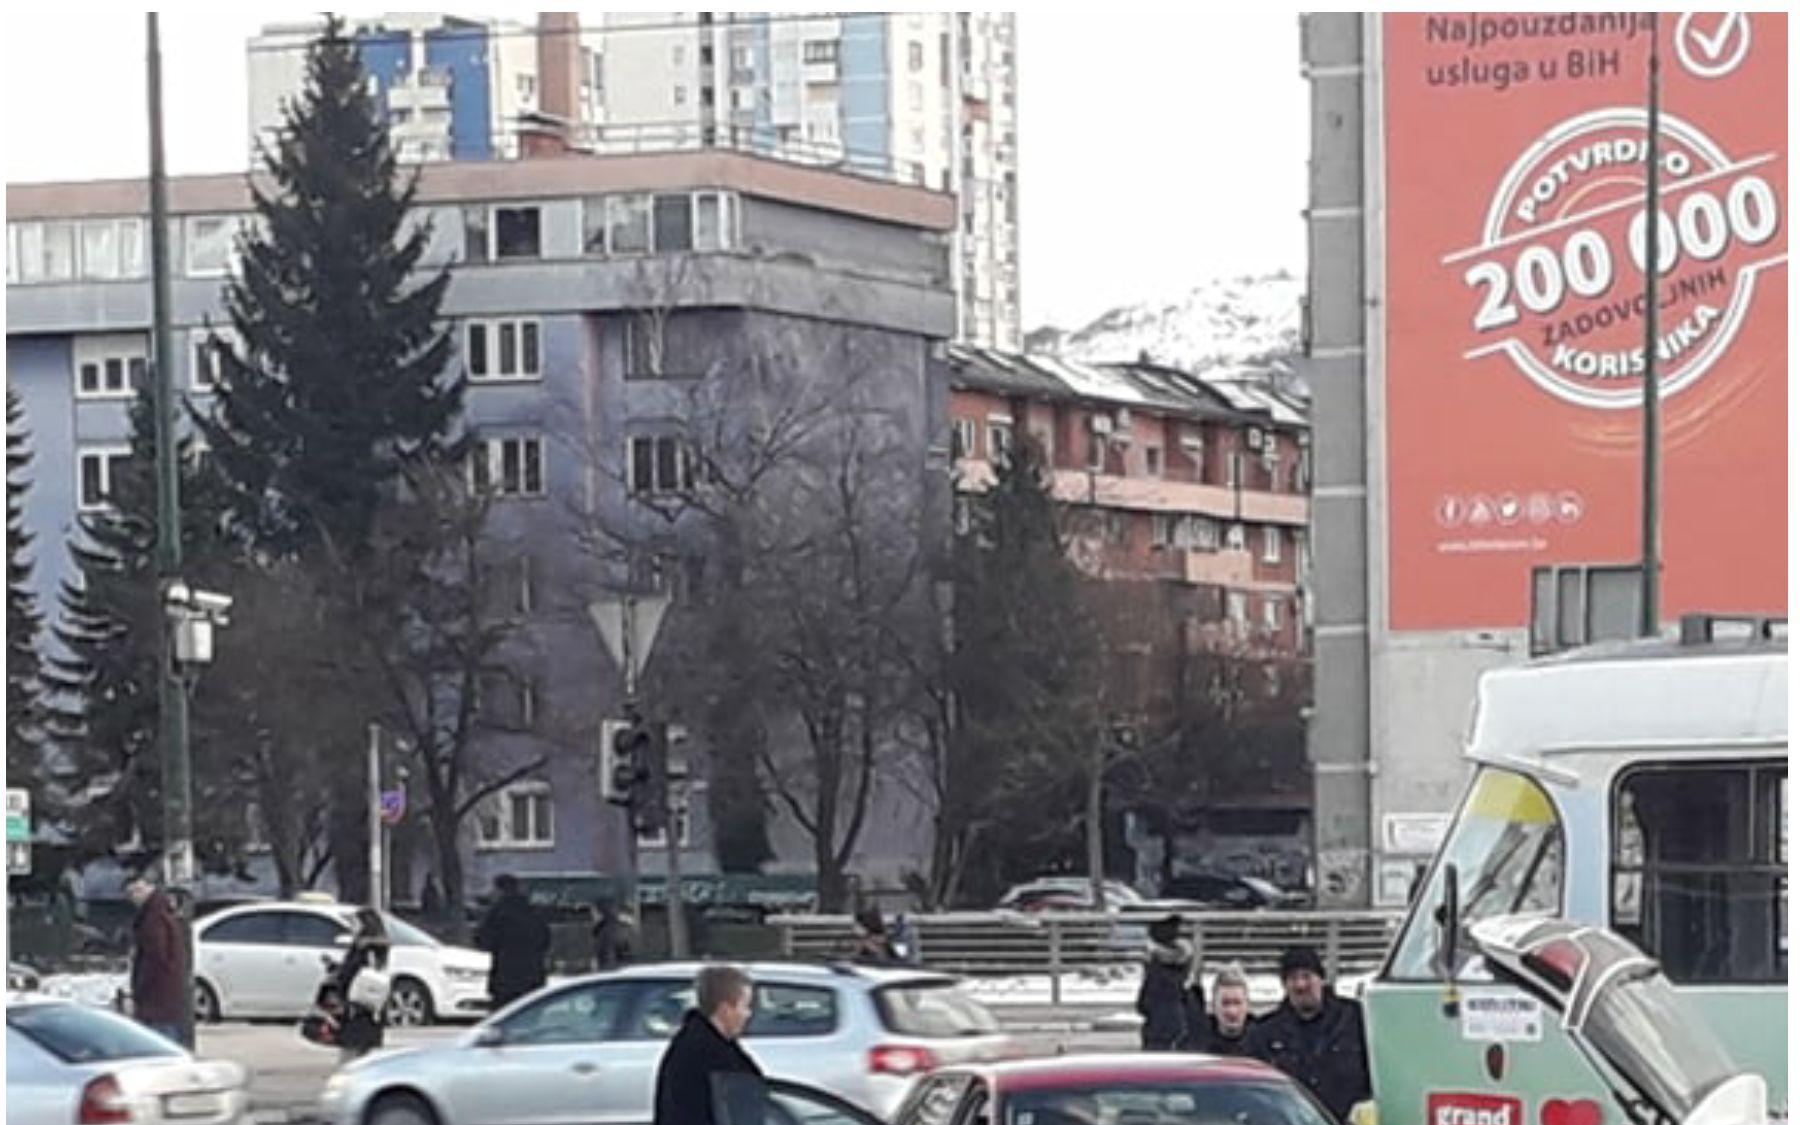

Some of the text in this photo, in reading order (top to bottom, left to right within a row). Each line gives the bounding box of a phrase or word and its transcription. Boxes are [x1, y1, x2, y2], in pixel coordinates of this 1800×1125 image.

[1427, 49, 1620, 91] usluga u BiH
[1517, 138, 1691, 223] POTVRDIO
[1464, 176, 1778, 331] 200 000
[1543, 269, 1726, 346] ZADOVOJNIH
